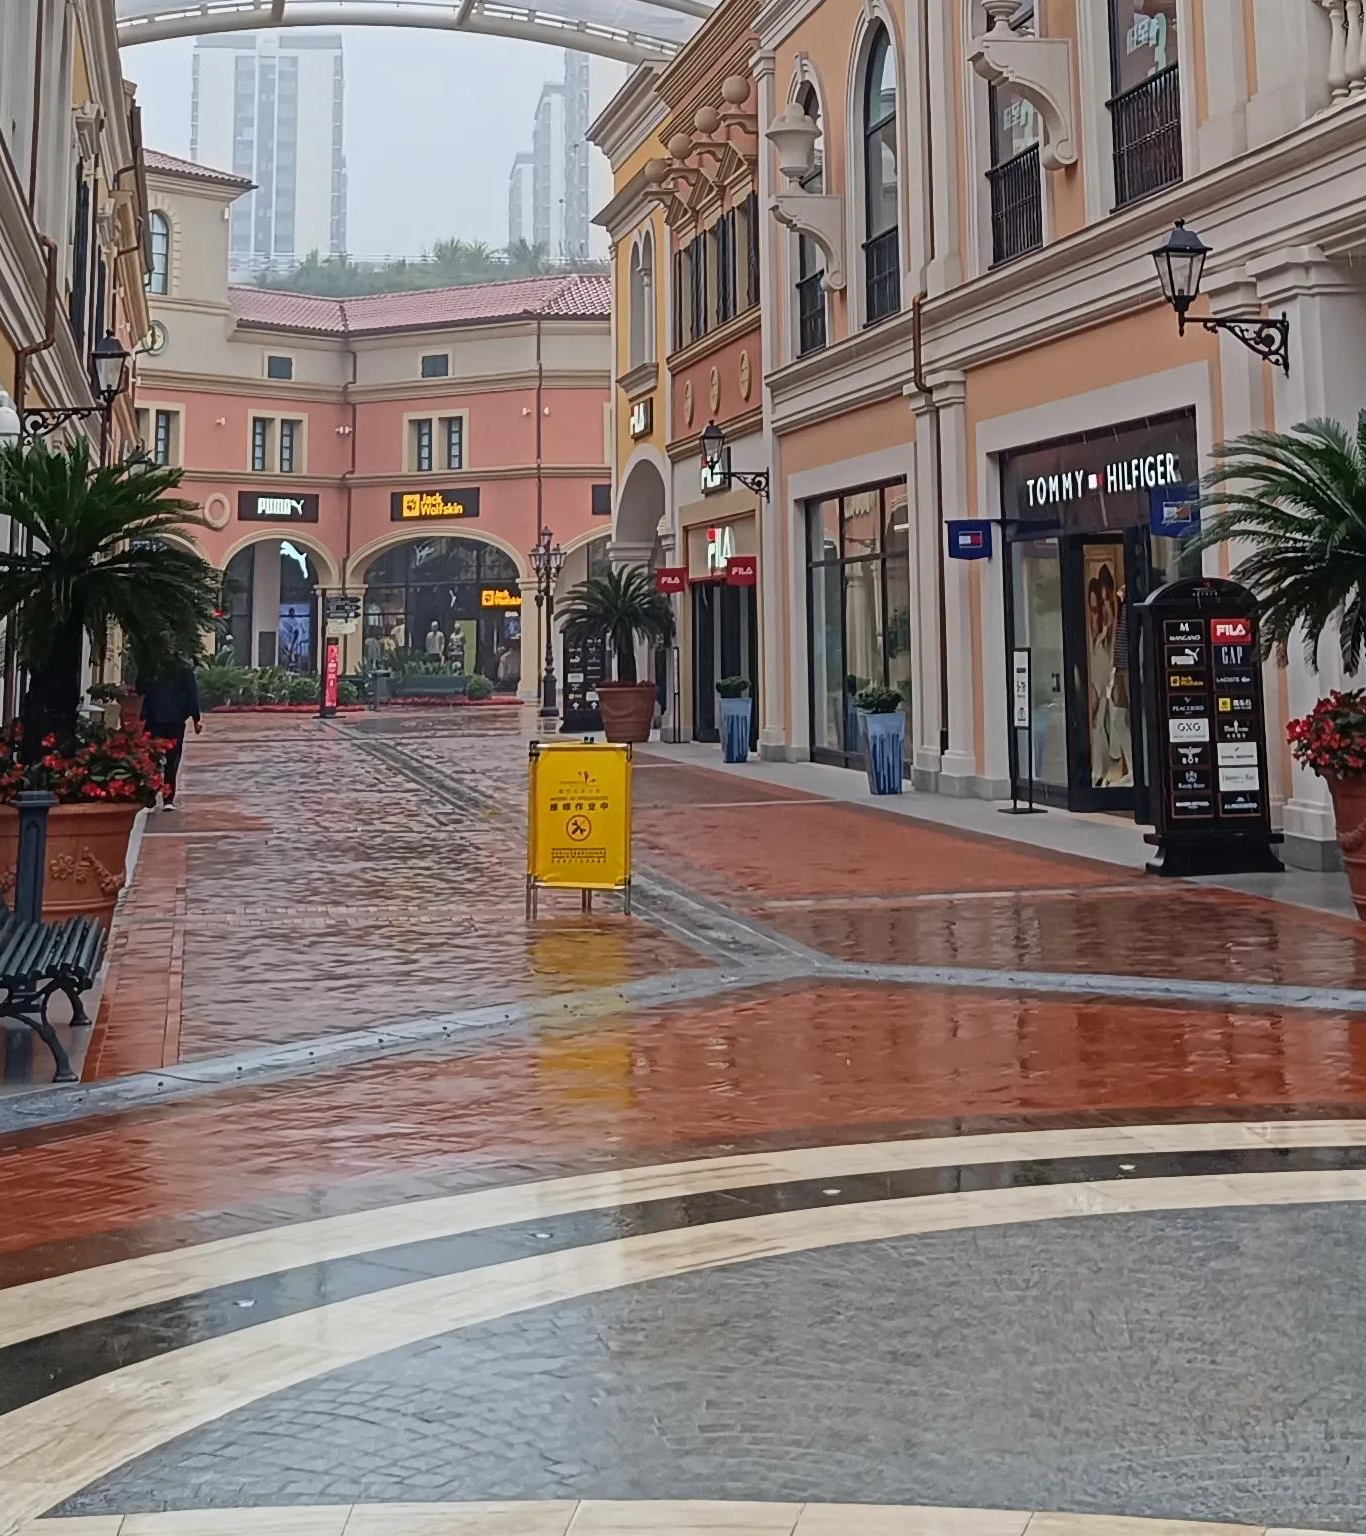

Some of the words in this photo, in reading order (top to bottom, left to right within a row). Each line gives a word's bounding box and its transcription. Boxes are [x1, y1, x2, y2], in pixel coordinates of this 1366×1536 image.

[1026, 469, 1084, 507] TOMMY
[1106, 452, 1179, 494] HILFIGER
[421, 492, 442, 504] Jack
[421, 502, 463, 516] Wolfskin
[706, 526, 733, 570] FILA
[731, 566, 753, 576] FILA
[661, 576, 680, 584] FILA
[1216, 624, 1247, 636] FILA
[1221, 646, 1243, 665] GAP
